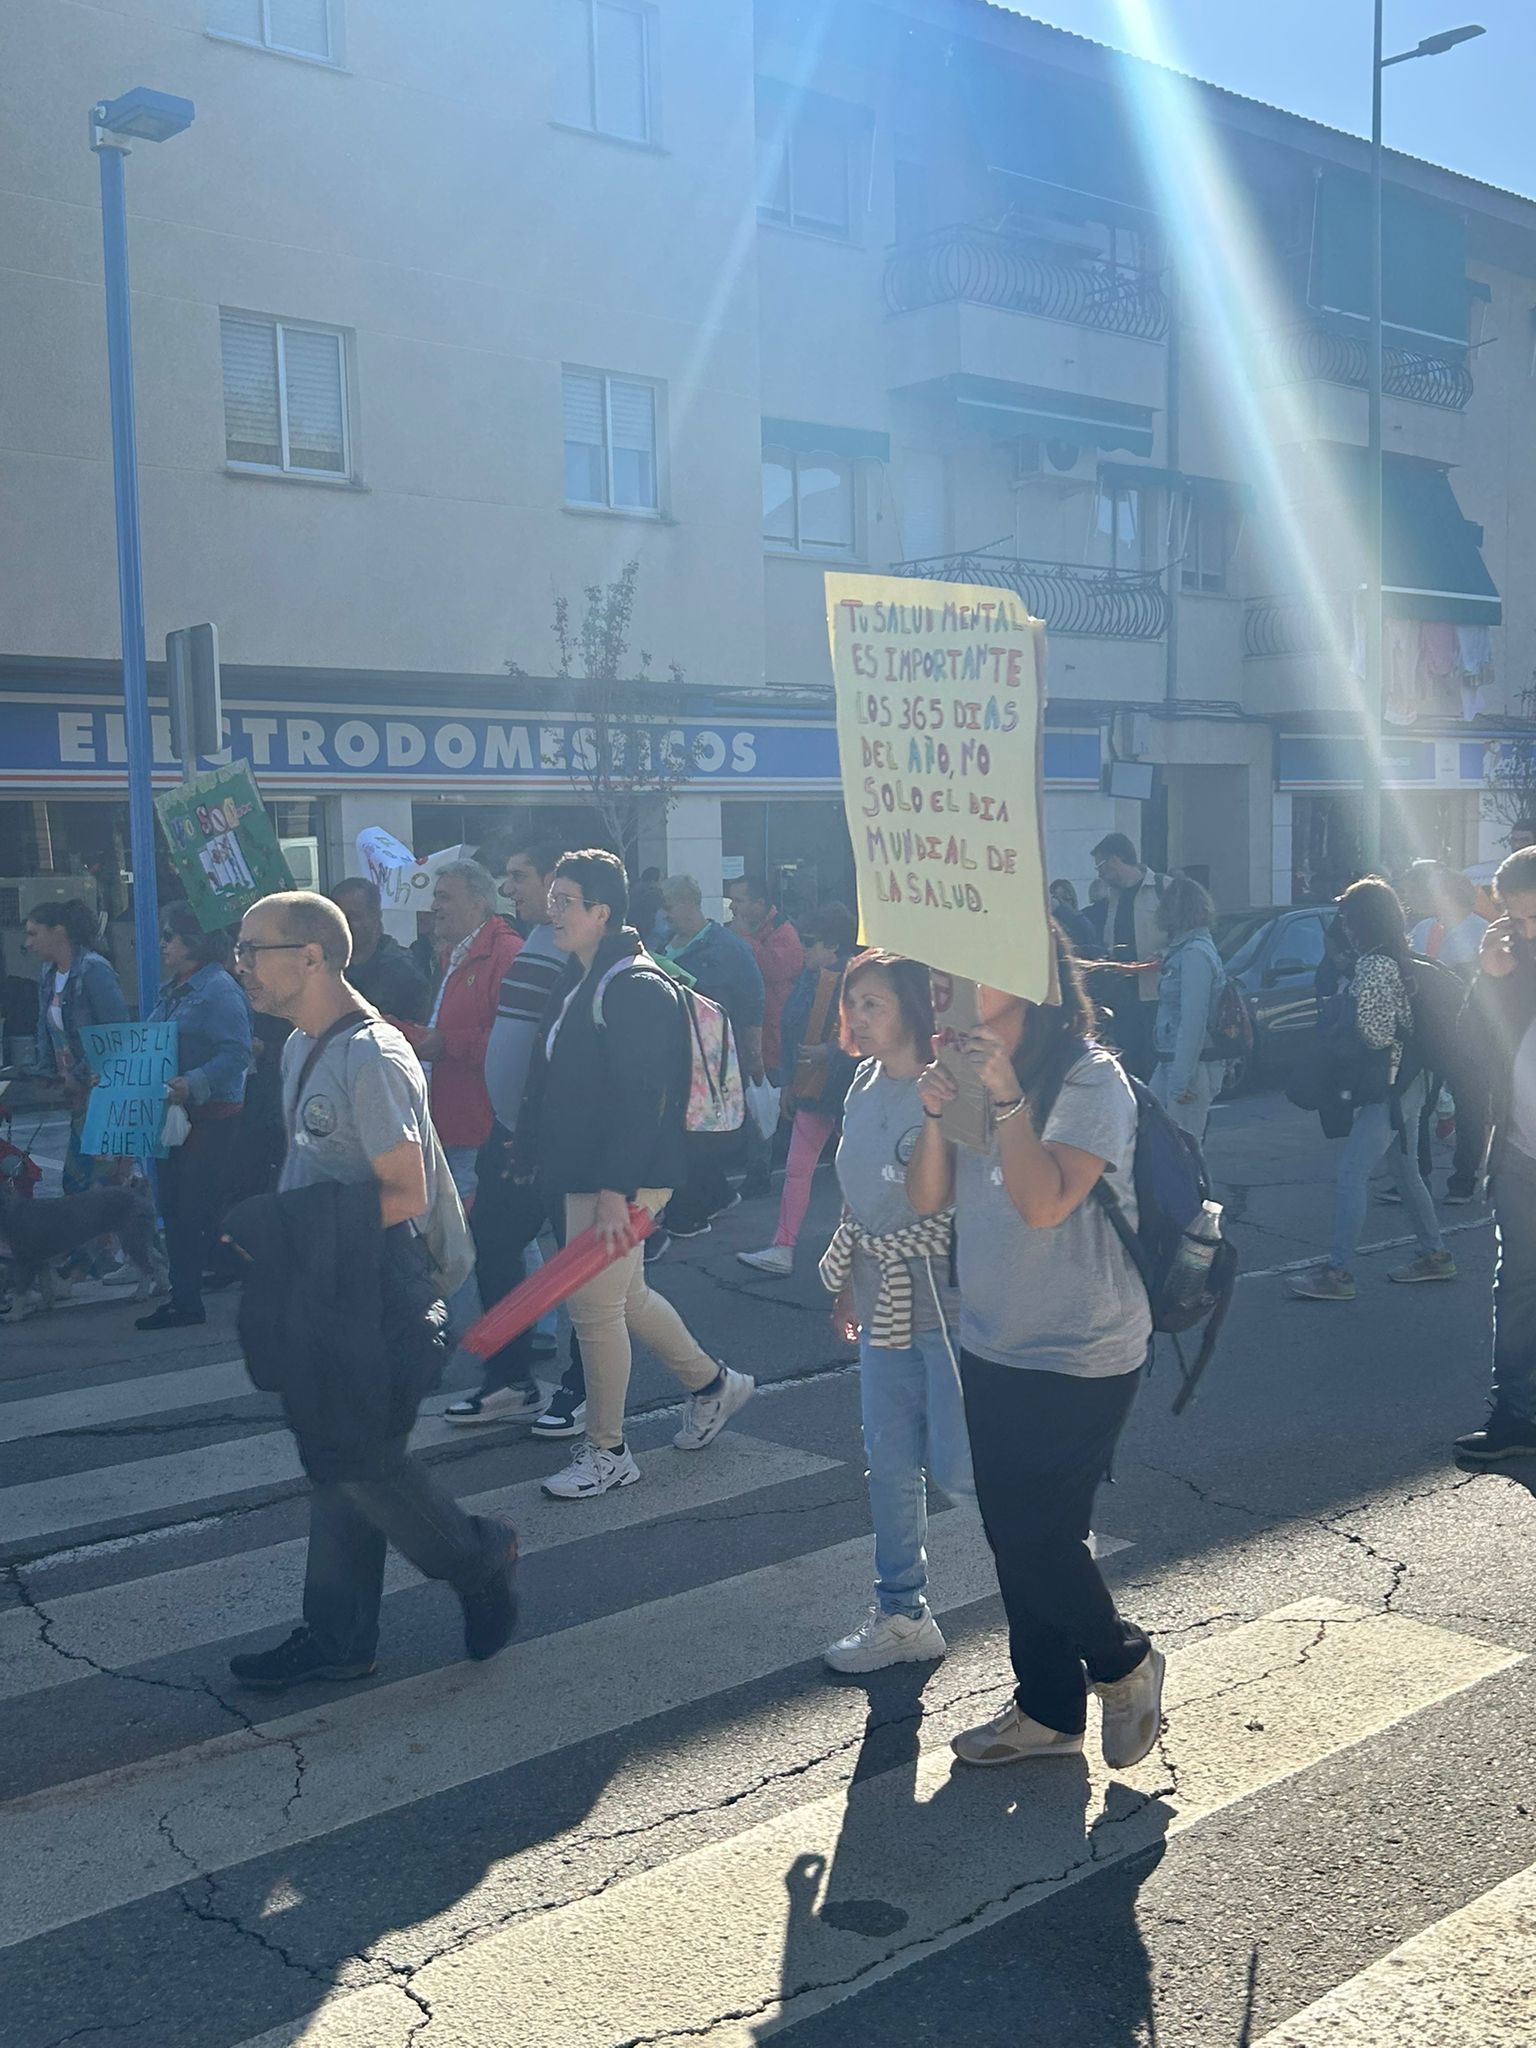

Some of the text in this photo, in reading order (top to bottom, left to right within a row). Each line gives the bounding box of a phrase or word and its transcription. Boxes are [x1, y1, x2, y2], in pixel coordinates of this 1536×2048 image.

[873, 600, 934, 634] SALUD
[941, 600, 1025, 633] MENTAL
[851, 642, 1023, 688] ES IMPORTANTE
[856, 690, 1019, 733] LOS 365 DIAS
[861, 734, 990, 780] DEL AÑO, NO
[862, 776, 1009, 823] SOLO EL DIA
[866, 825, 1017, 875] MUNDIAL DE
[875, 869, 901, 904] LA
[91, 1031, 121, 1055] DIA
[130, 1028, 148, 1053] DE
